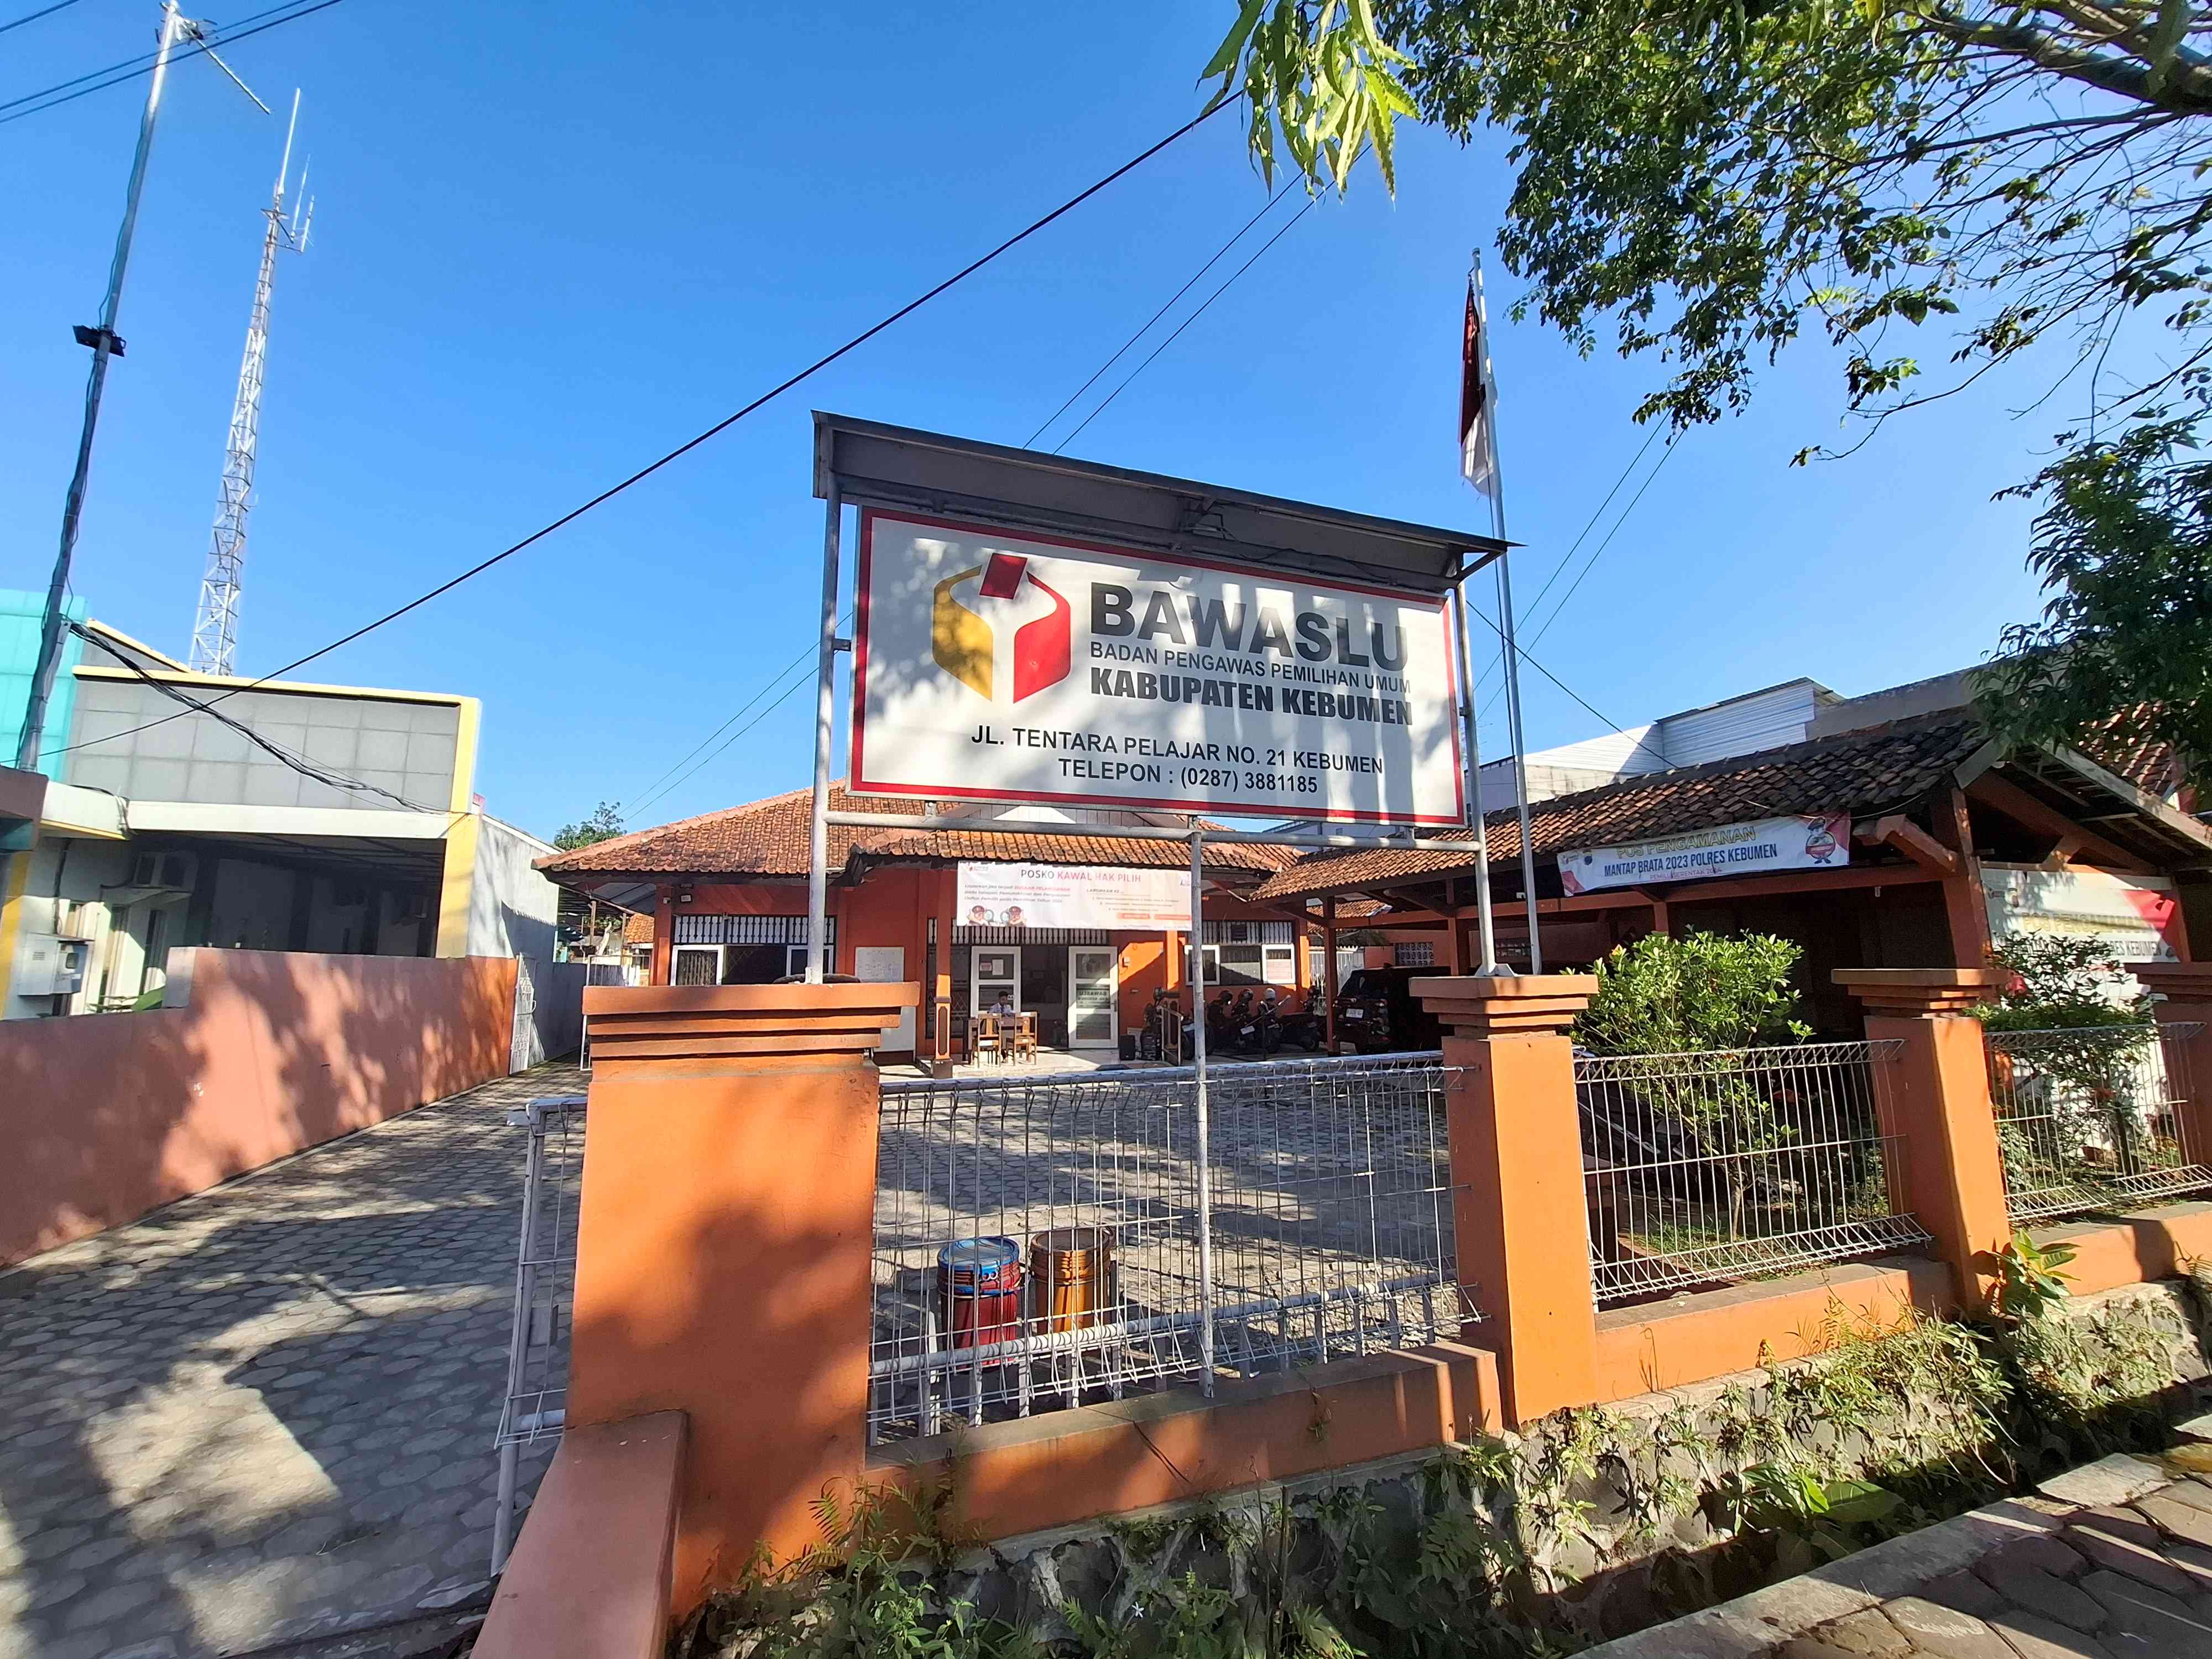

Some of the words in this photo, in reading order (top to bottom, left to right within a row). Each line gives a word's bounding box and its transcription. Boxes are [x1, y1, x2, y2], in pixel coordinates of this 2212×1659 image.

[1091, 582, 1408, 672] BAWASLU
[1091, 641, 1158, 665] BADAN
[1164, 650, 1266, 677] PENGAWAS
[1271, 663, 1359, 688] PEMILIHAN
[1365, 675, 1411, 694] UMUM
[1091, 666, 1274, 712] KABUPATEN
[1282, 687, 1412, 726] KEBUMEN
[971, 724, 1005, 745] JL.
[1012, 728, 1118, 753] TENTARA
[1124, 737, 1220, 761] PELAJAR
[1226, 745, 1260, 765] NO.
[1266, 748, 1285, 766] 21
[1293, 750, 1383, 774] KEBUMEN
[1058, 758, 1161, 782] TELEPON
[1181, 766, 1239, 792] (0287)
[1244, 772, 1318, 793] 3881185
[1604, 862, 1636, 877] MANTAP
[1638, 859, 1664, 873] BRATA
[1665, 855, 1688, 870] 2023
[1690, 850, 1725, 867] POLRES
[1728, 843, 1778, 863] KEBUMEN
[1616, 846, 1644, 859] POS
[1647, 826, 1757, 855] PENGAMANAN
[1021, 869, 1055, 879] POSKO
[1057, 871, 1092, 881] KAWAL
[1095, 872, 1115, 881] HAK
[1118, 873, 1141, 883] PILIH
